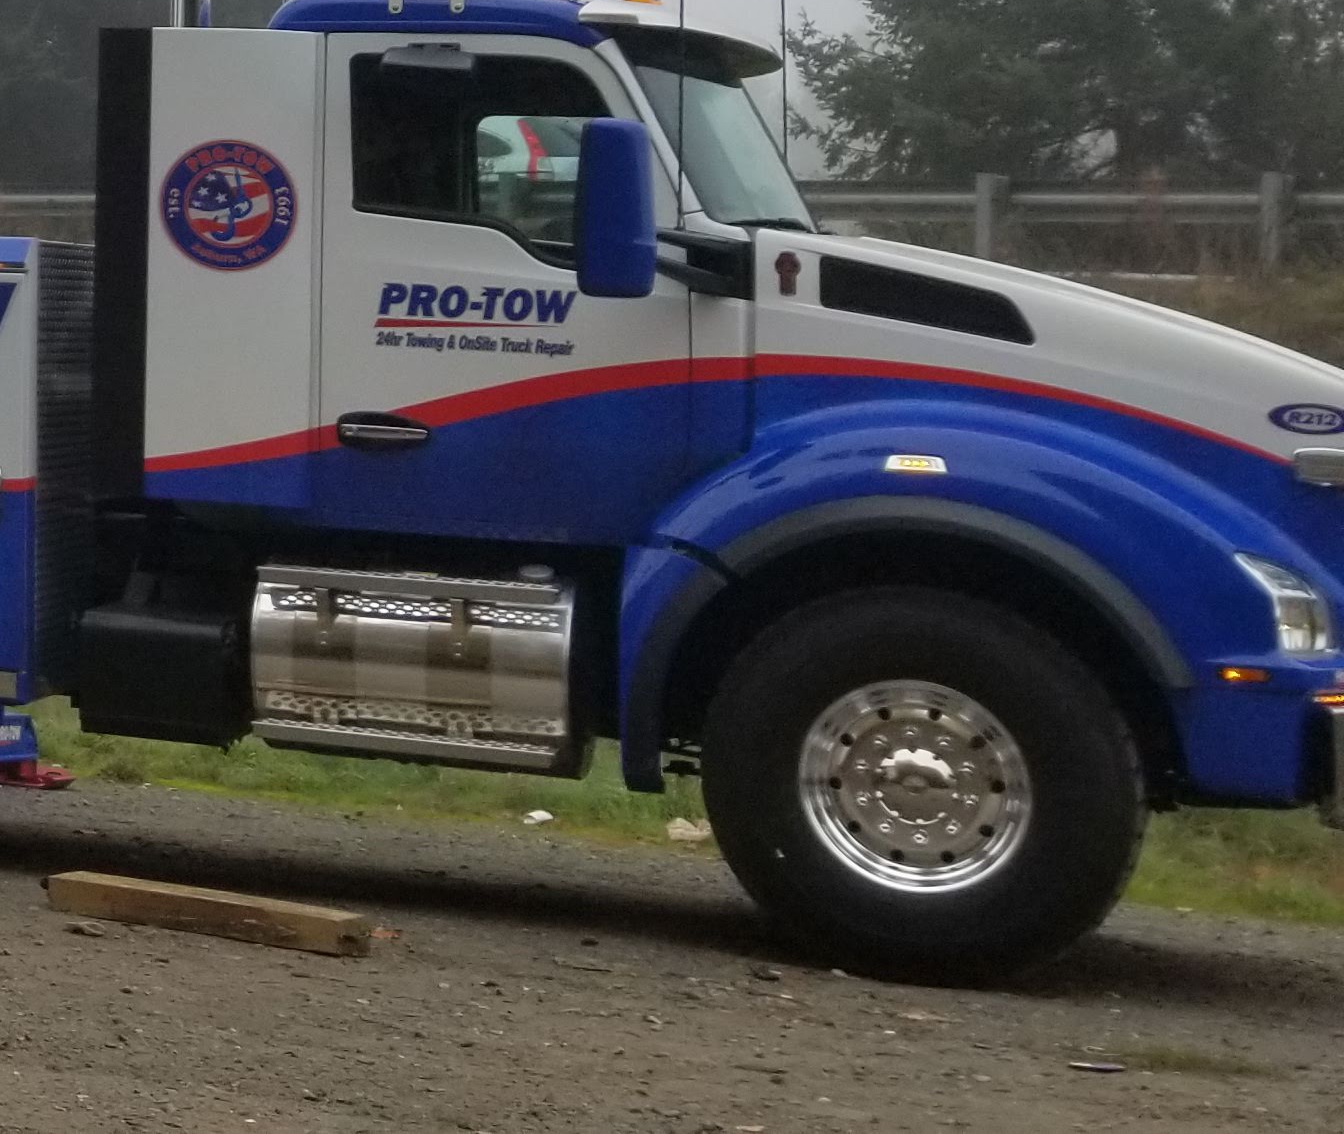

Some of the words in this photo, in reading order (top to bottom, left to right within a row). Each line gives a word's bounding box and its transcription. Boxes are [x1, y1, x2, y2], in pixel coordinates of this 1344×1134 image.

[378, 282, 577, 324] PRO-TOW
[376, 331, 404, 347] 24hr
[406, 332, 446, 352] Towing
[447, 335, 456, 350] &
[501, 337, 533, 354] Truck
[535, 338, 575, 357] Repair
